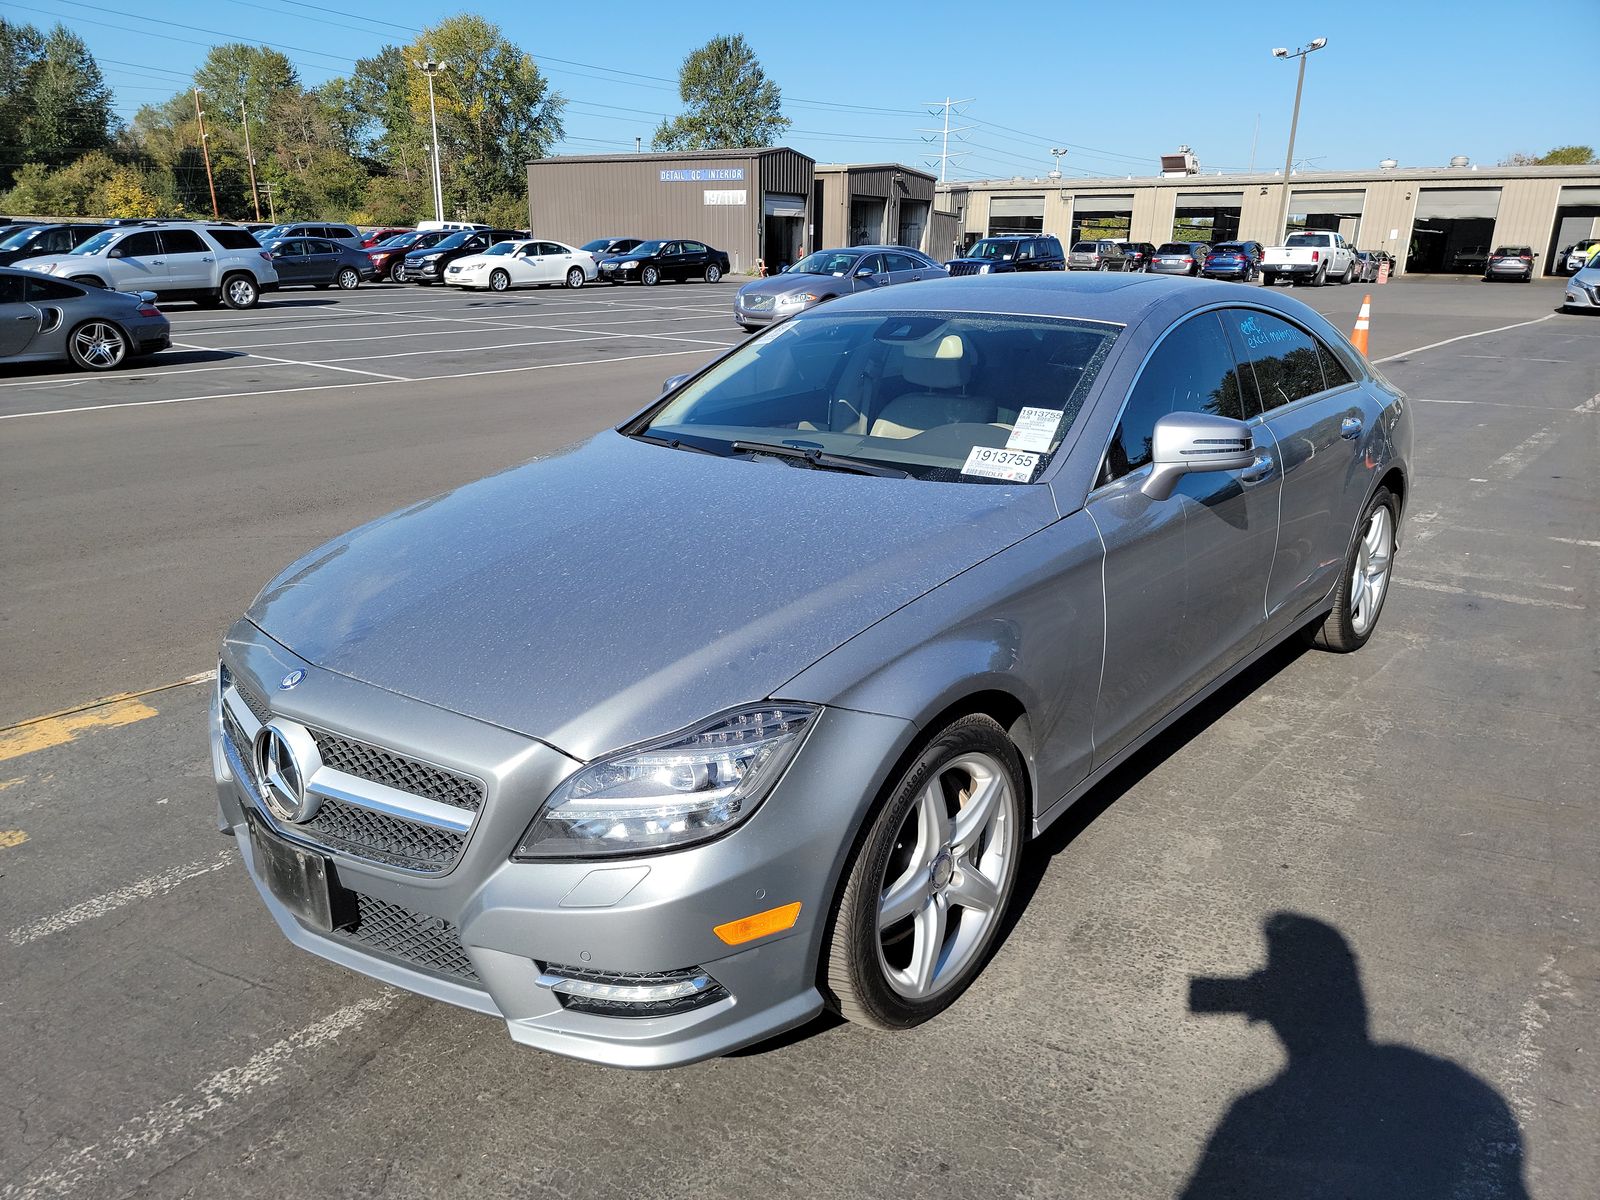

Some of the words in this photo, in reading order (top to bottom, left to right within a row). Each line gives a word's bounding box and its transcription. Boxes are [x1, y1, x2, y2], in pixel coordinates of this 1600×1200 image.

[661, 170, 685, 180] DETAIL
[691, 170, 701, 180] QC
[708, 169, 743, 180] INTERIOR
[1021, 409, 1062, 420] 1913755
[975, 449, 1034, 467] 1913755
